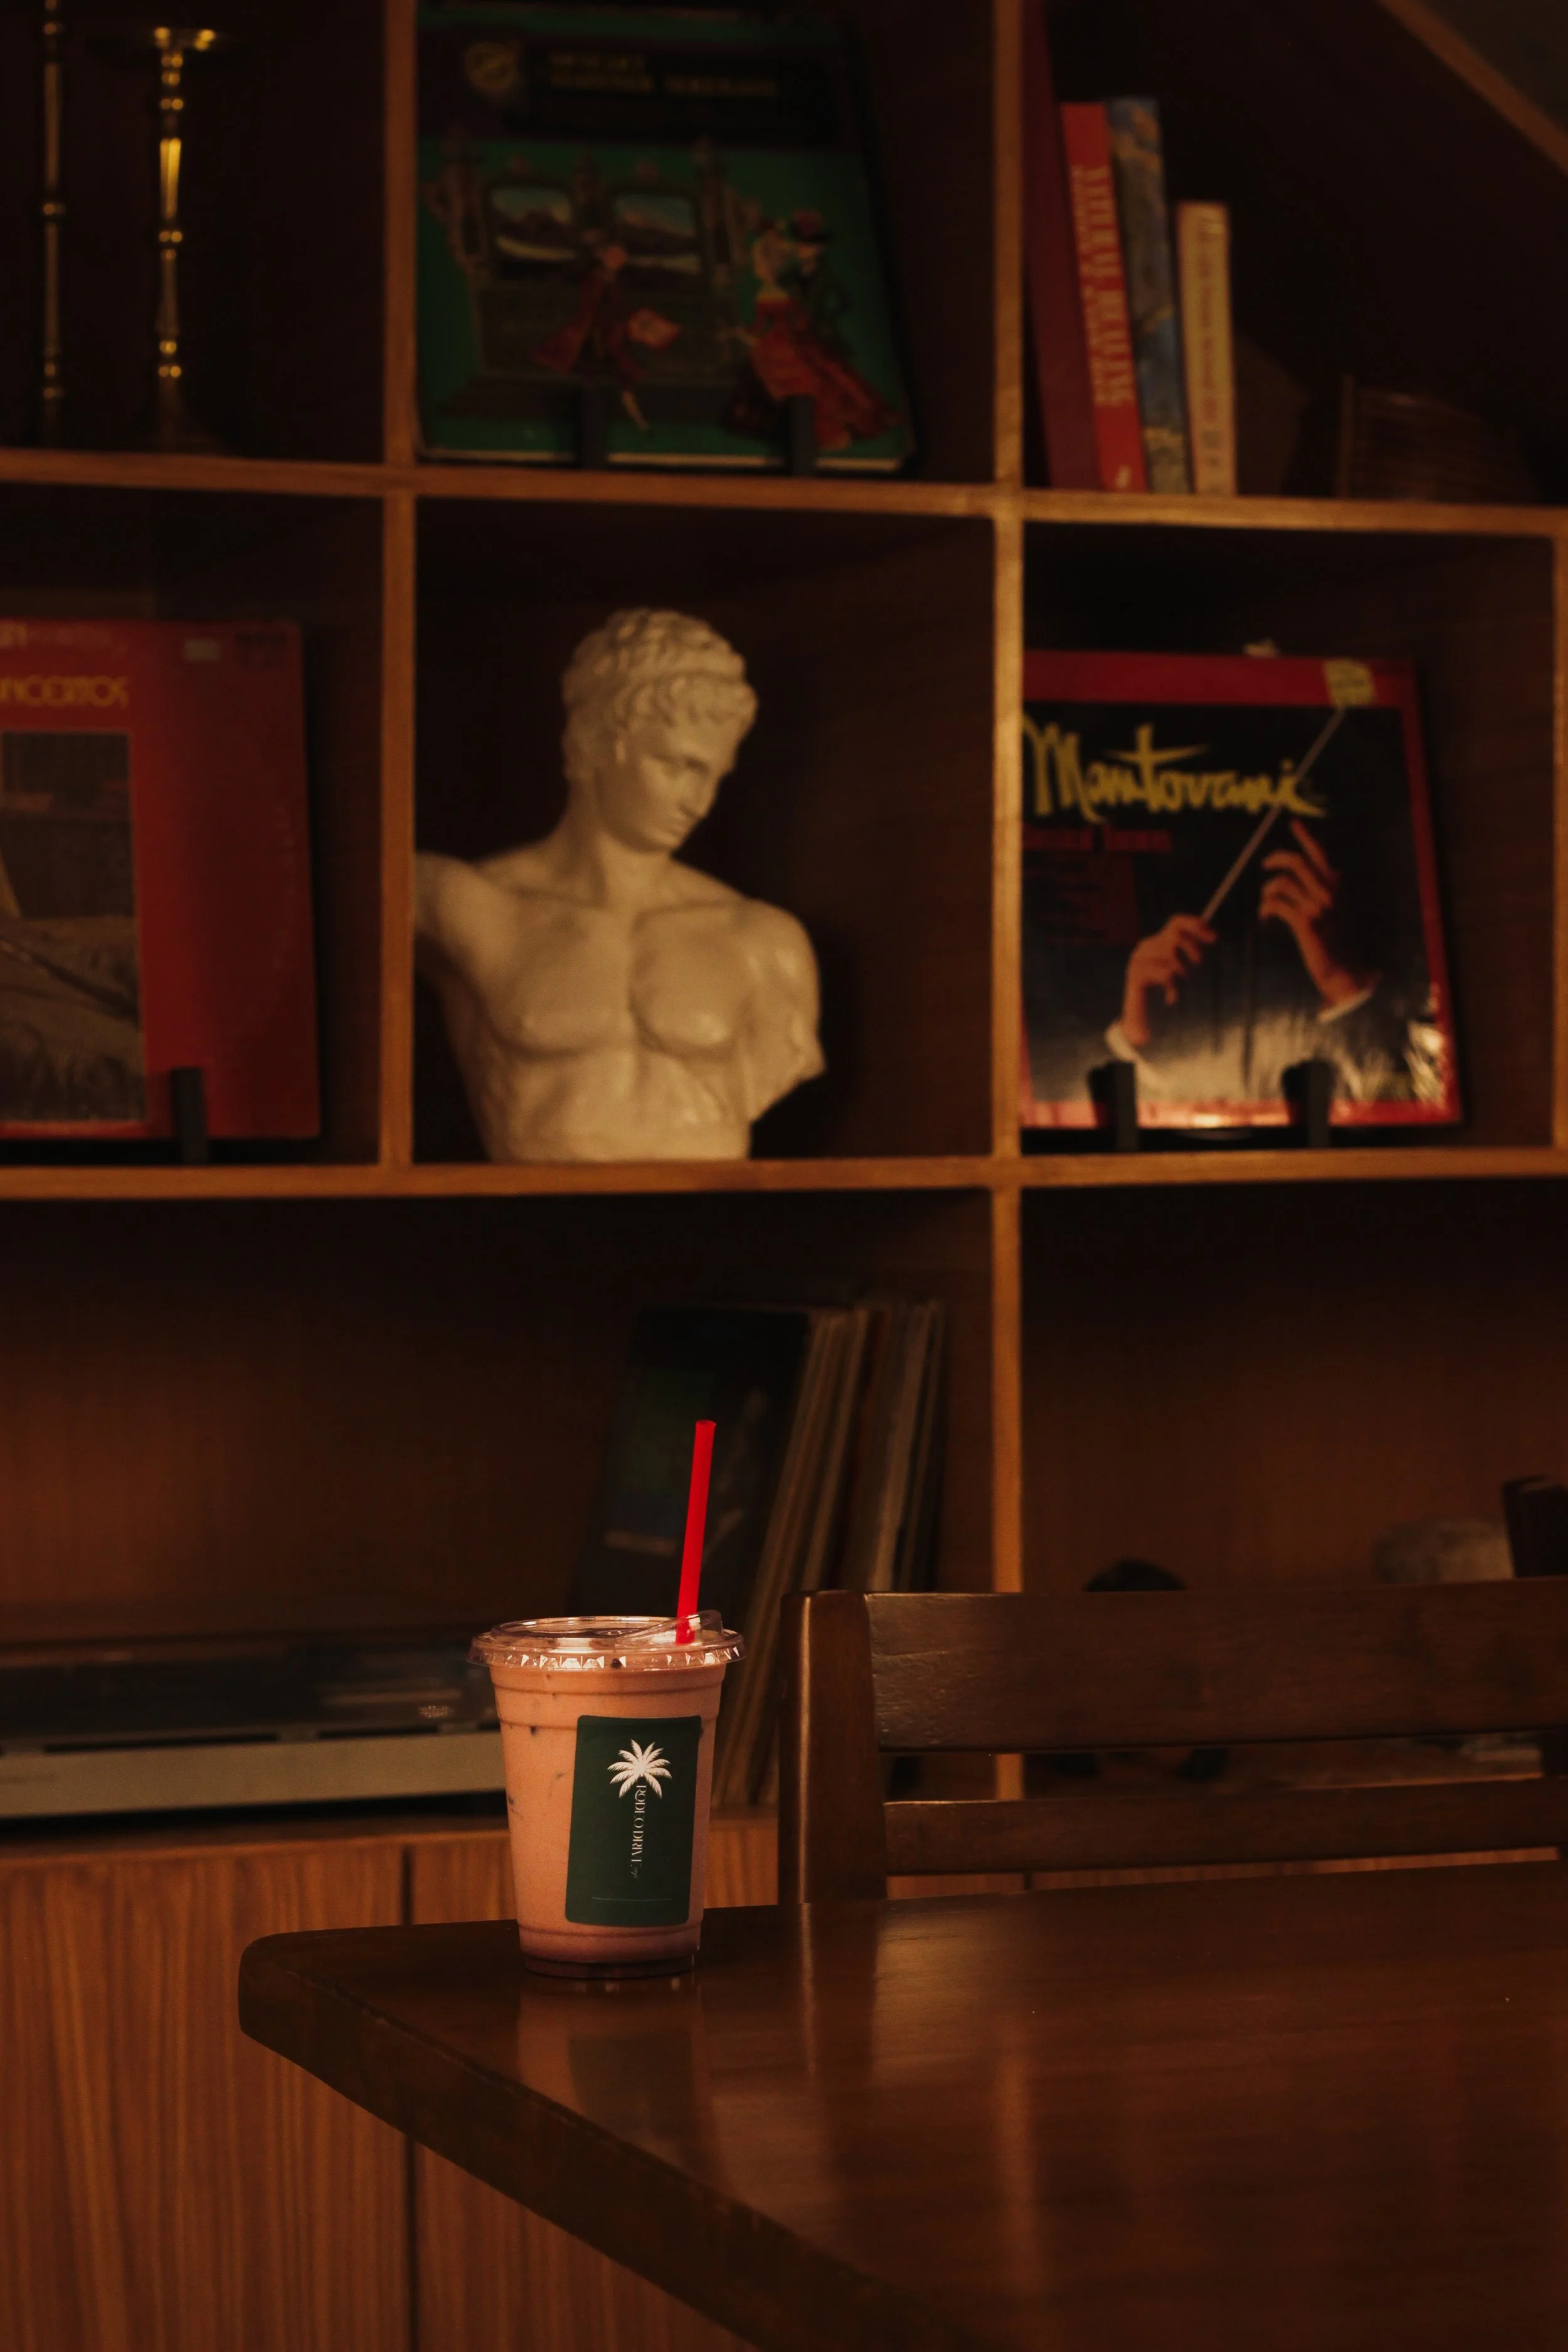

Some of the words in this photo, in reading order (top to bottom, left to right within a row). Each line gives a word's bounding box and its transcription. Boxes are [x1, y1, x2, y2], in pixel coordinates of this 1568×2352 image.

[1023, 710, 1327, 824] Mantovani
[633, 1785, 647, 1828] RODEO
[630, 1831, 644, 1867] DRIVE
